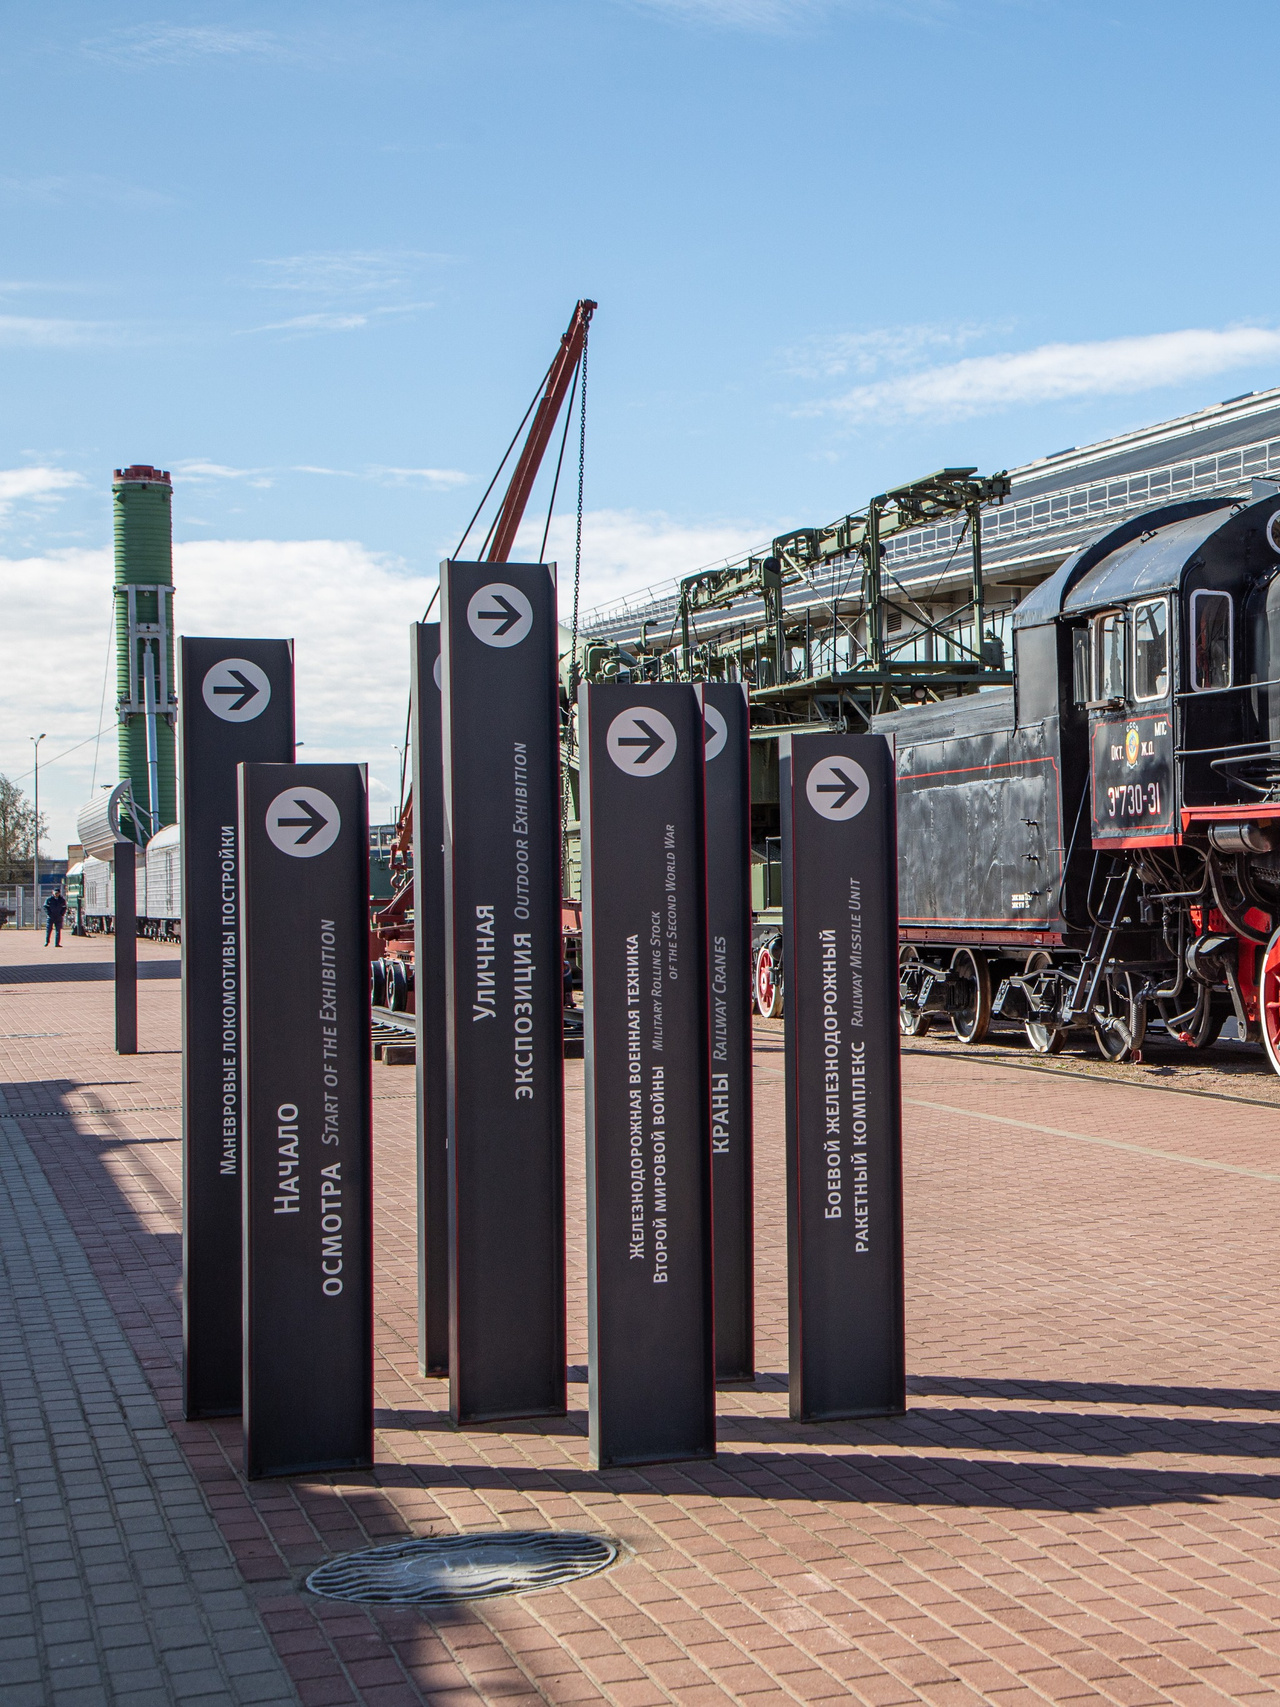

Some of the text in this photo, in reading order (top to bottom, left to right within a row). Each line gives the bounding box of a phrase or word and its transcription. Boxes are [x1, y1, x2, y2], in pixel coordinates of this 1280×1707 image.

[1154, 720, 1167, 737] МПС
[512, 741, 530, 920] OUTDOOR EXHIBITION
[663, 823, 680, 980] OF THE SECOND WORLD WAR
[218, 825, 237, 1175] МАНЕВРОВЫЕ ЛОКОМОТИВЫ ПОСТРОЙКИ
[472, 905, 497, 1022] УЛИЧНАЯ
[513, 933, 537, 1101] ЭКСПОЗИЦИЯ
[649, 910, 664, 1052] MILITARY ROLLING STOCK
[711, 935, 728, 1061] RAILWAY CRANES
[848, 877, 864, 1028] RAILWAY MISSILE UNIT
[318, 918, 340, 1147] START OF THE EXHIBITION
[626, 934, 646, 1260] ЖЕЛЕЗНОДОРОЖНАЯ ВОЕННАЯ ТЕХНИКА
[819, 929, 843, 1219] БОЕВОЙ ЖЕЛЕЗНОДОРОЖНЫЙ
[273, 1103, 300, 1214] НАЧАЛО
[648, 1066, 669, 1284] ВТОРОЙ МИРОВОЙ ВОЙНЫ
[711, 1073, 730, 1154] КРАНЫ
[850, 1041, 870, 1253] РАКЕТНЫЙ КОМПЛЕКС
[320, 1162, 344, 1297] ОСМОТРА
